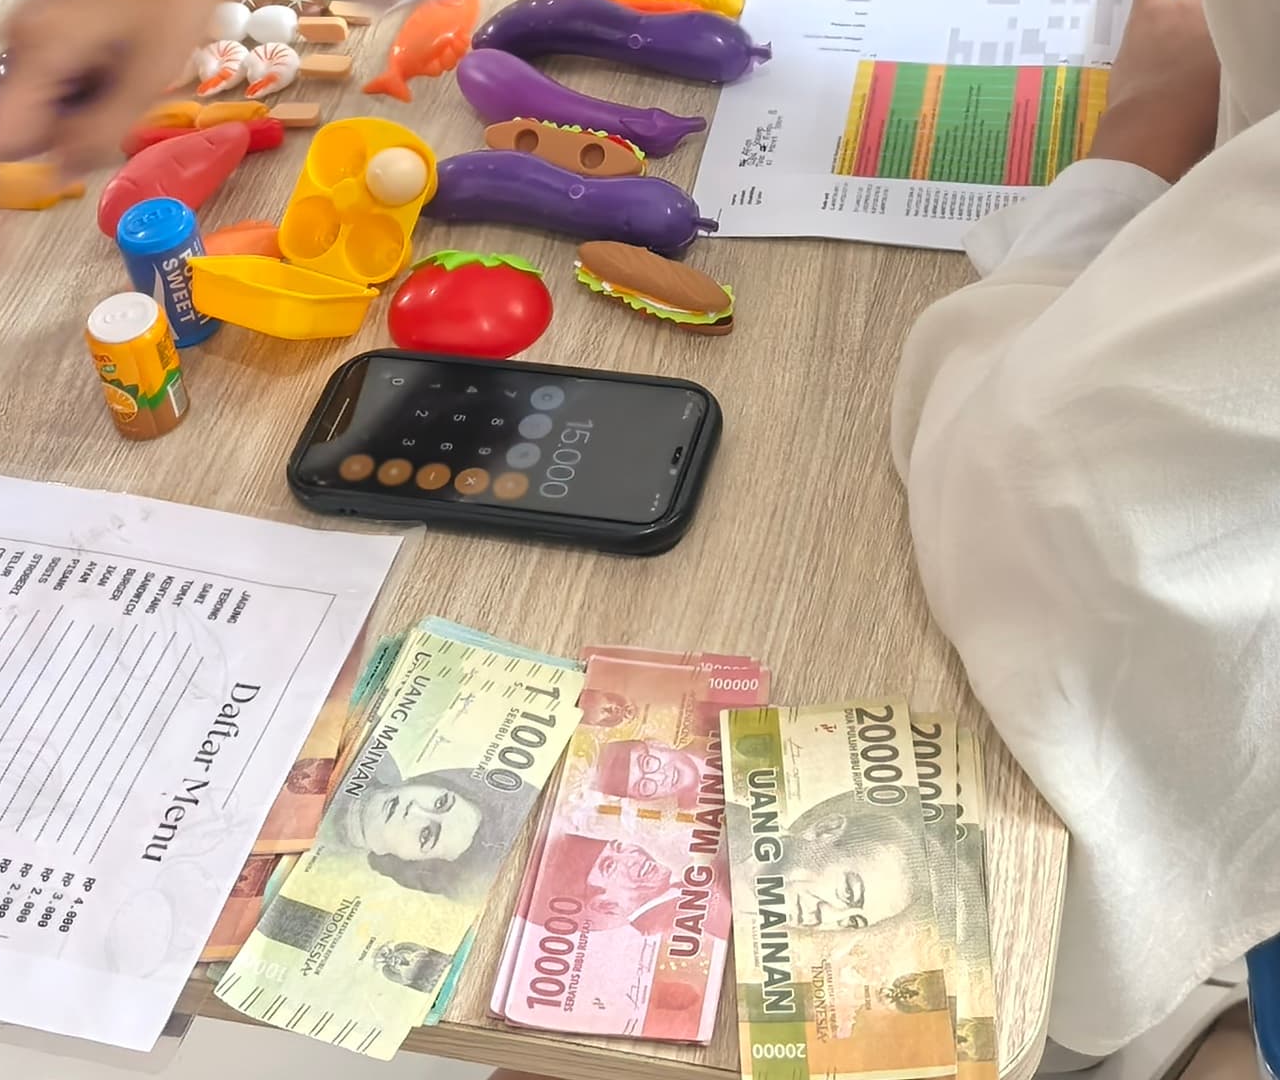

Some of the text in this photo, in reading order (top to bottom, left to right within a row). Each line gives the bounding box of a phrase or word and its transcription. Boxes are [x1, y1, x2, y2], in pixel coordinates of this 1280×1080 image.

[160, 256, 196, 324] SWEET
[390, 375, 404, 387] 0
[401, 436, 415, 447] 3
[414, 408, 428, 418] 2
[439, 384, 479, 451] 4 5 6
[489, 416, 503, 427] 8
[476, 445, 491, 456] 9
[537, 419, 595, 501] 15.000
[7, 552, 43, 596] STROBERI
[36, 555, 62, 584] SOSIS
[51, 557, 81, 592] PISANG
[76, 559, 98, 584] AYAM
[95, 563, 118, 587] IKAN
[107, 566, 137, 602] BURGER
[121, 570, 156, 616] SANDWICH
[143, 574, 176, 615] KENTANG
[170, 579, 195, 608] TOMAT
[390, 673, 431, 723] UANG
[708, 678, 759, 690] 100000
[14, 581, 214, 924] SAWI RP 2.000
[36, 586, 234, 928] TERONG RP 3.000
[57, 589, 252, 933] JAGUNG RP 4.000
[140, 681, 262, 863] Daftar Menu
[344, 723, 399, 799] MAINAN
[471, 706, 520, 780] SERIBU RUPIAH
[484, 709, 558, 794] 1000
[844, 708, 864, 801] DUA PULUH RIBU RUPIAH
[854, 704, 906, 805] 20000
[17, 861, 34, 879] RP
[747, 768, 794, 1014] UANG MAINAN
[300, 897, 353, 975] INDONESIA
[668, 861, 715, 956] UANG
[524, 896, 583, 1010] 100000
[563, 918, 592, 1013] SERATUS RIBU RUPIAH
[810, 964, 827, 1040] INDONESIA
[751, 1042, 806, 1059] 20000
